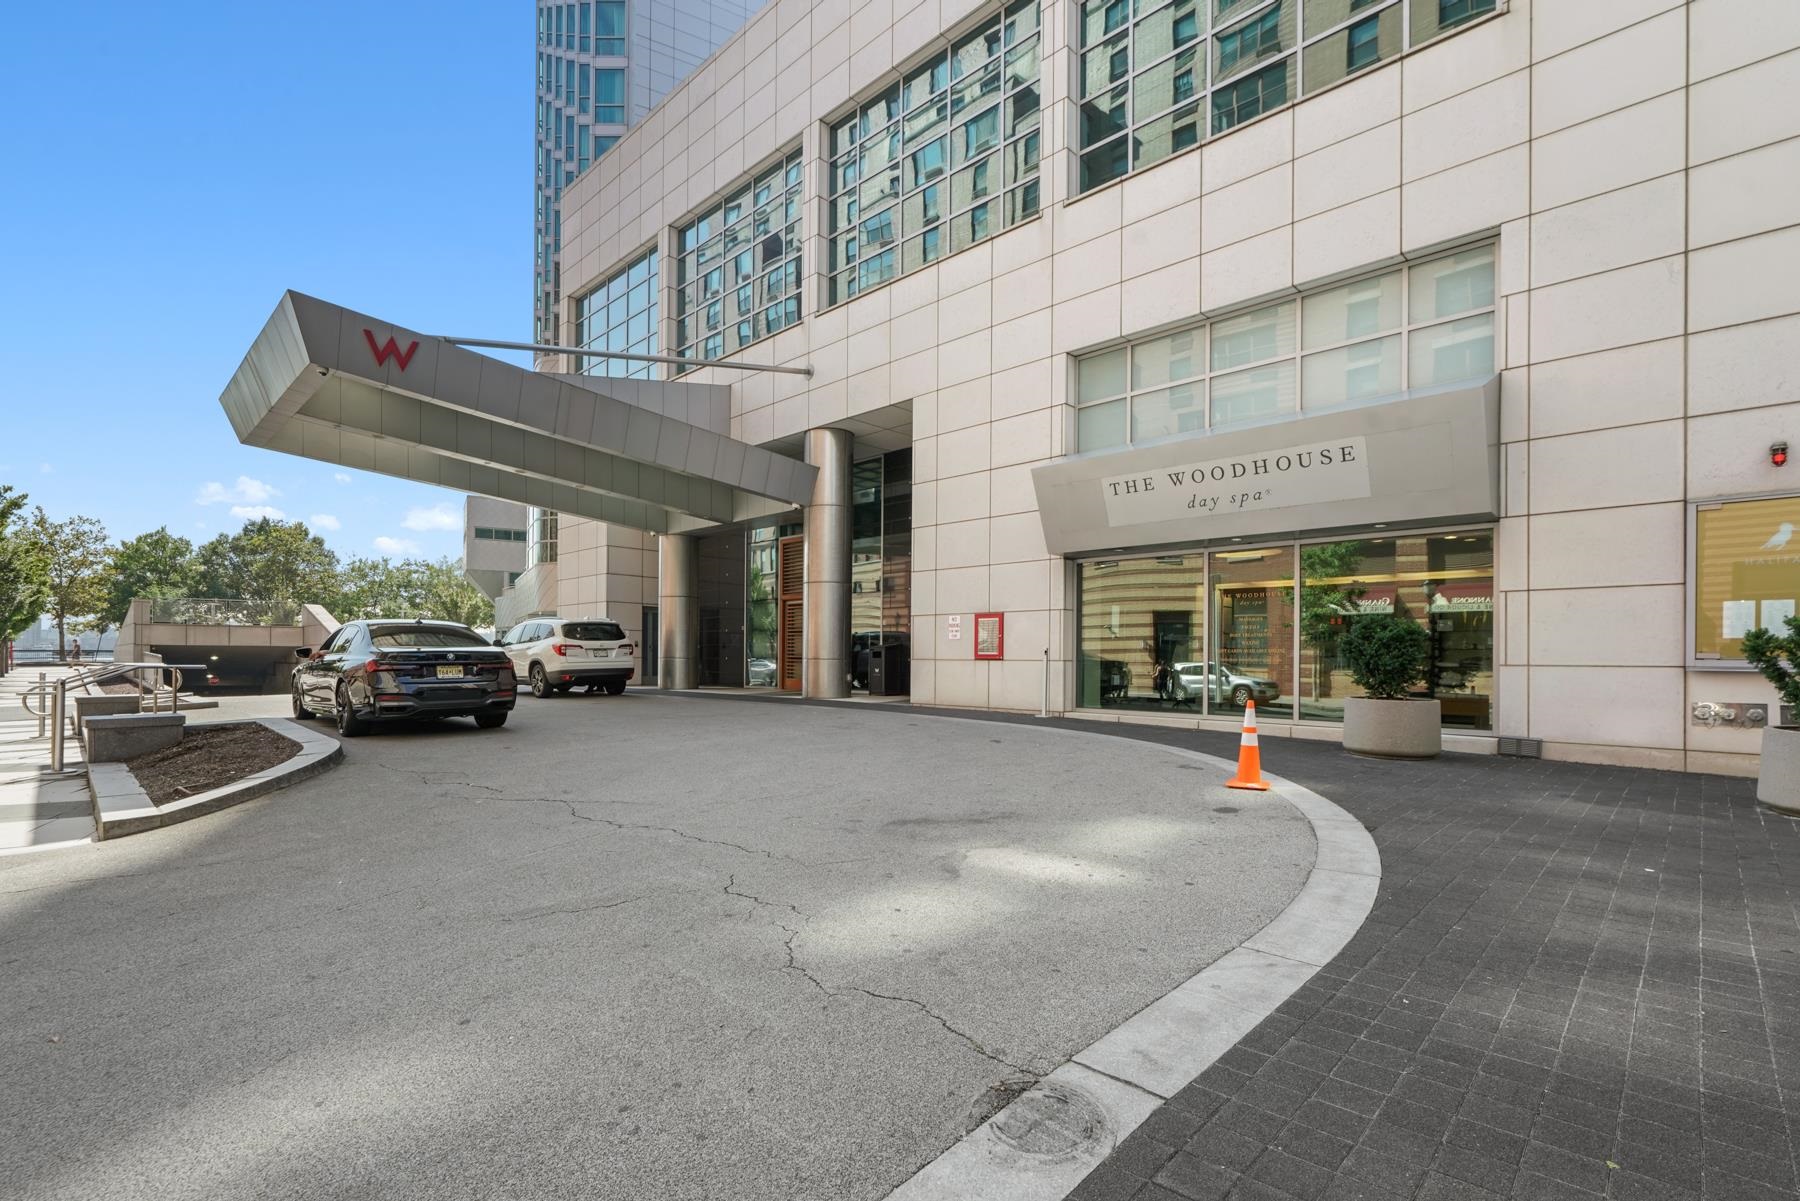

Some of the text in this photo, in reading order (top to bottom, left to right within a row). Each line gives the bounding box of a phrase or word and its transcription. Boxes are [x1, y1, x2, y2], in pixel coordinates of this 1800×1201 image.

[363, 328, 419, 373] W
[1109, 445, 1356, 496] THE WOODHOUSE
[1187, 494, 1219, 511] day
